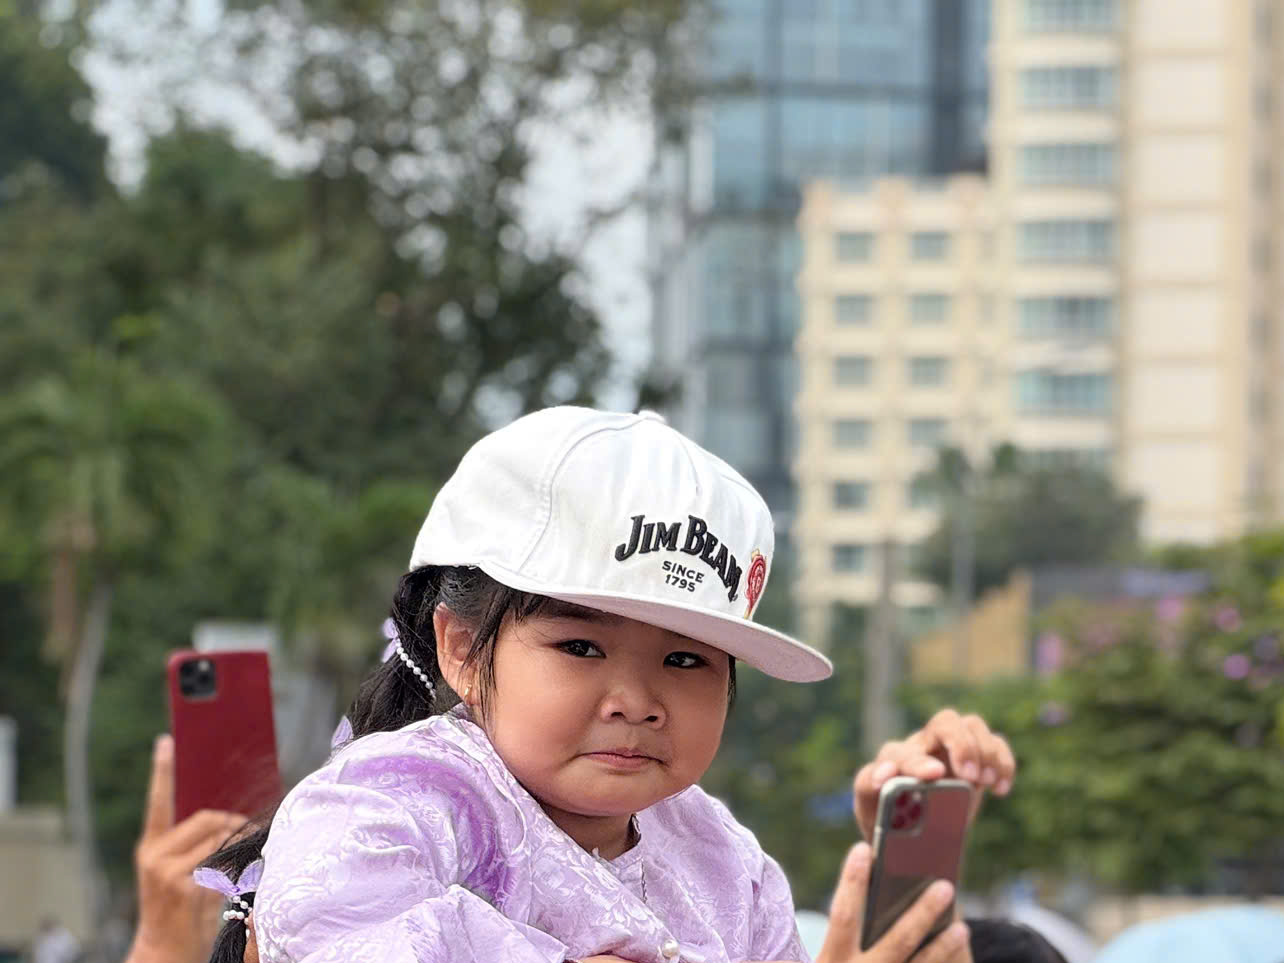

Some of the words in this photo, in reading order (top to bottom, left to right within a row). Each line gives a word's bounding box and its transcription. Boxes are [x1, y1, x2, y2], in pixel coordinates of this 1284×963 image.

[614, 514, 682, 562] JIM
[680, 514, 743, 603] BEAM
[661, 560, 705, 583] SINCE
[664, 574, 696, 593] 1795
